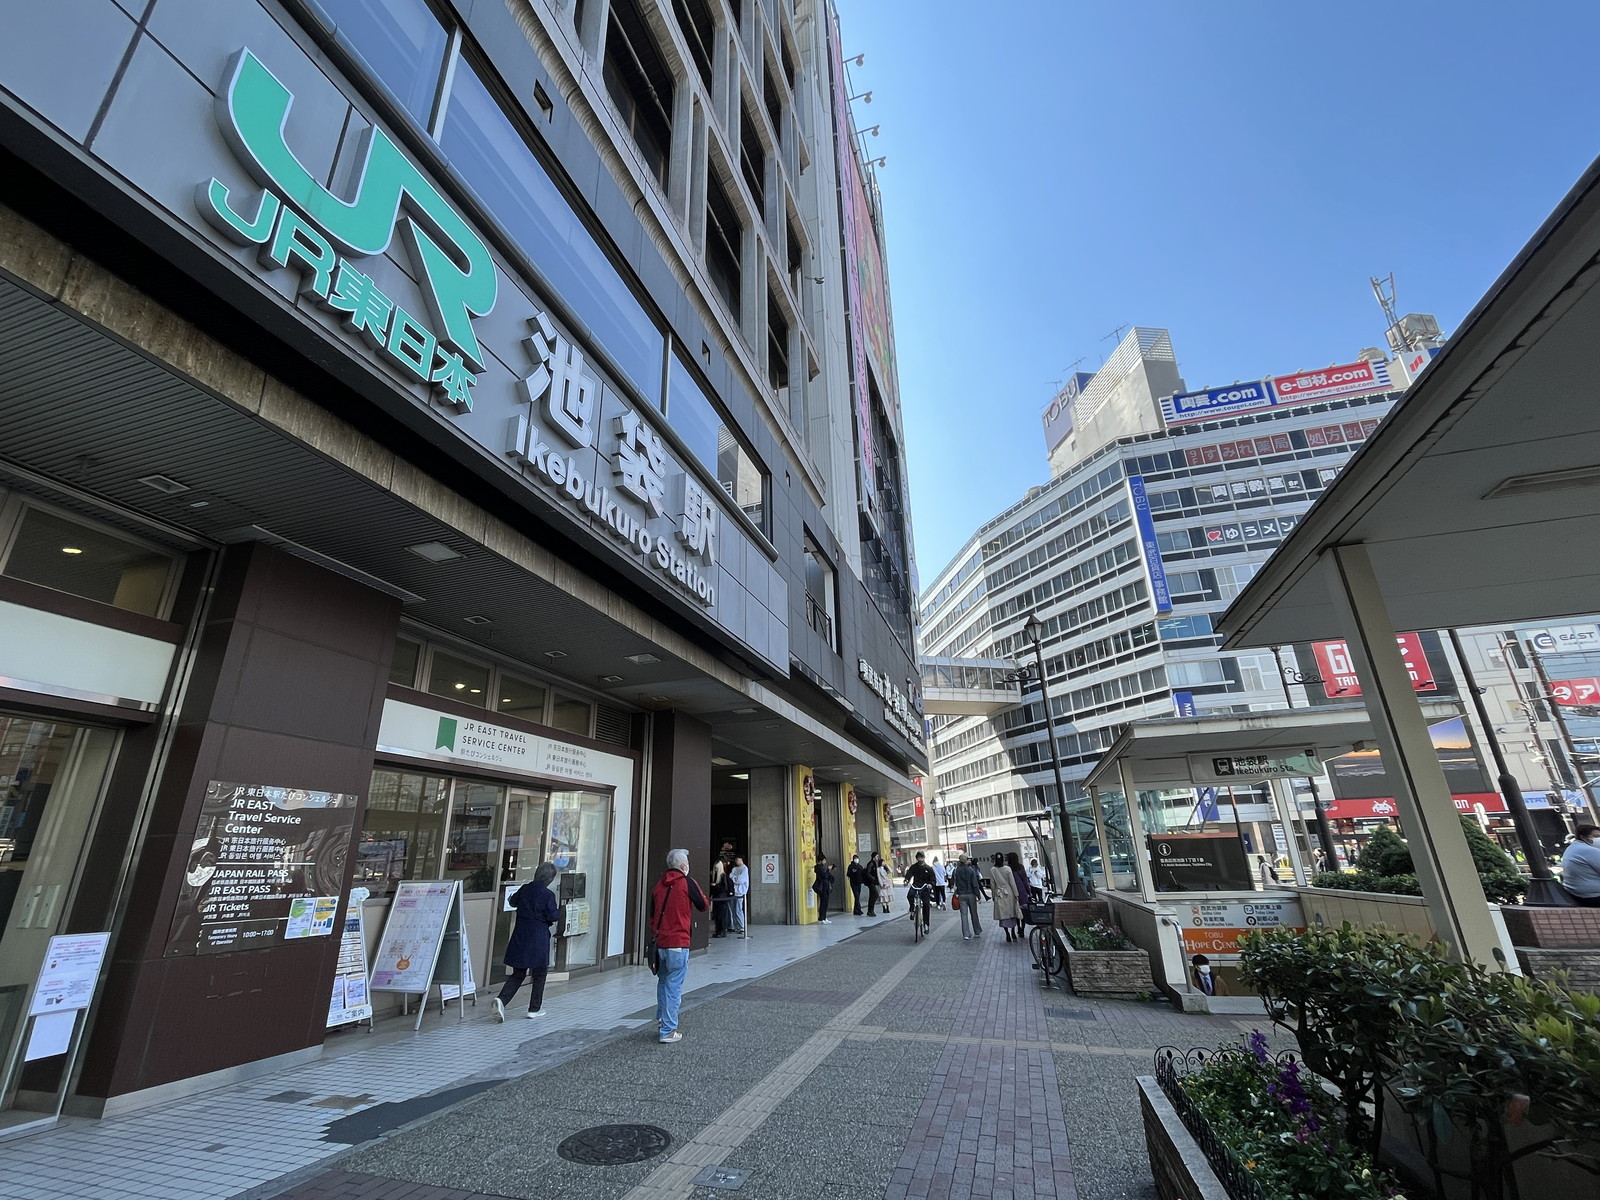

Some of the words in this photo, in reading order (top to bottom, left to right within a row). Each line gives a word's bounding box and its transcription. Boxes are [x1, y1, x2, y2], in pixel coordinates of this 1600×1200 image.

[222, 46, 498, 373] JR
[204, 177, 478, 413] JR東日本
[1280, 368, 1369, 392] e-画材.com
[1043, 378, 1077, 428] TOBU
[519, 311, 717, 566] 池袋駅
[1204, 438, 1289, 461] すみれ薬局
[1132, 481, 1147, 511] TOBU
[508, 414, 652, 555] Ikebukuro
[652, 535, 716, 607] Station
[1559, 631, 1595, 640] EAST
[463, 722, 475, 732] JR
[477, 725, 497, 737] EAST
[500, 731, 527, 744] TRAVEL
[462, 736, 495, 750] SERVICE
[498, 743, 526, 756] CENTER
[1234, 755, 1270, 767] 池袋駅
[1236, 766, 1278, 775] Ikebukuro
[1280, 765, 1297, 773] Sta.
[231, 799, 244, 809] JR
[247, 800, 275, 810] EAST
[228, 811, 262, 822] Travel
[264, 813, 301, 825] Service
[225, 823, 263, 834] Center
[213, 870, 243, 878] JAPAN
[245, 870, 266, 878] RAIL
[209, 886, 221, 895] JR
[223, 885, 248, 894] EAST
[248, 885, 271, 894] PASS
[203, 903, 216, 913] JR
[218, 903, 249, 912] Tickets
